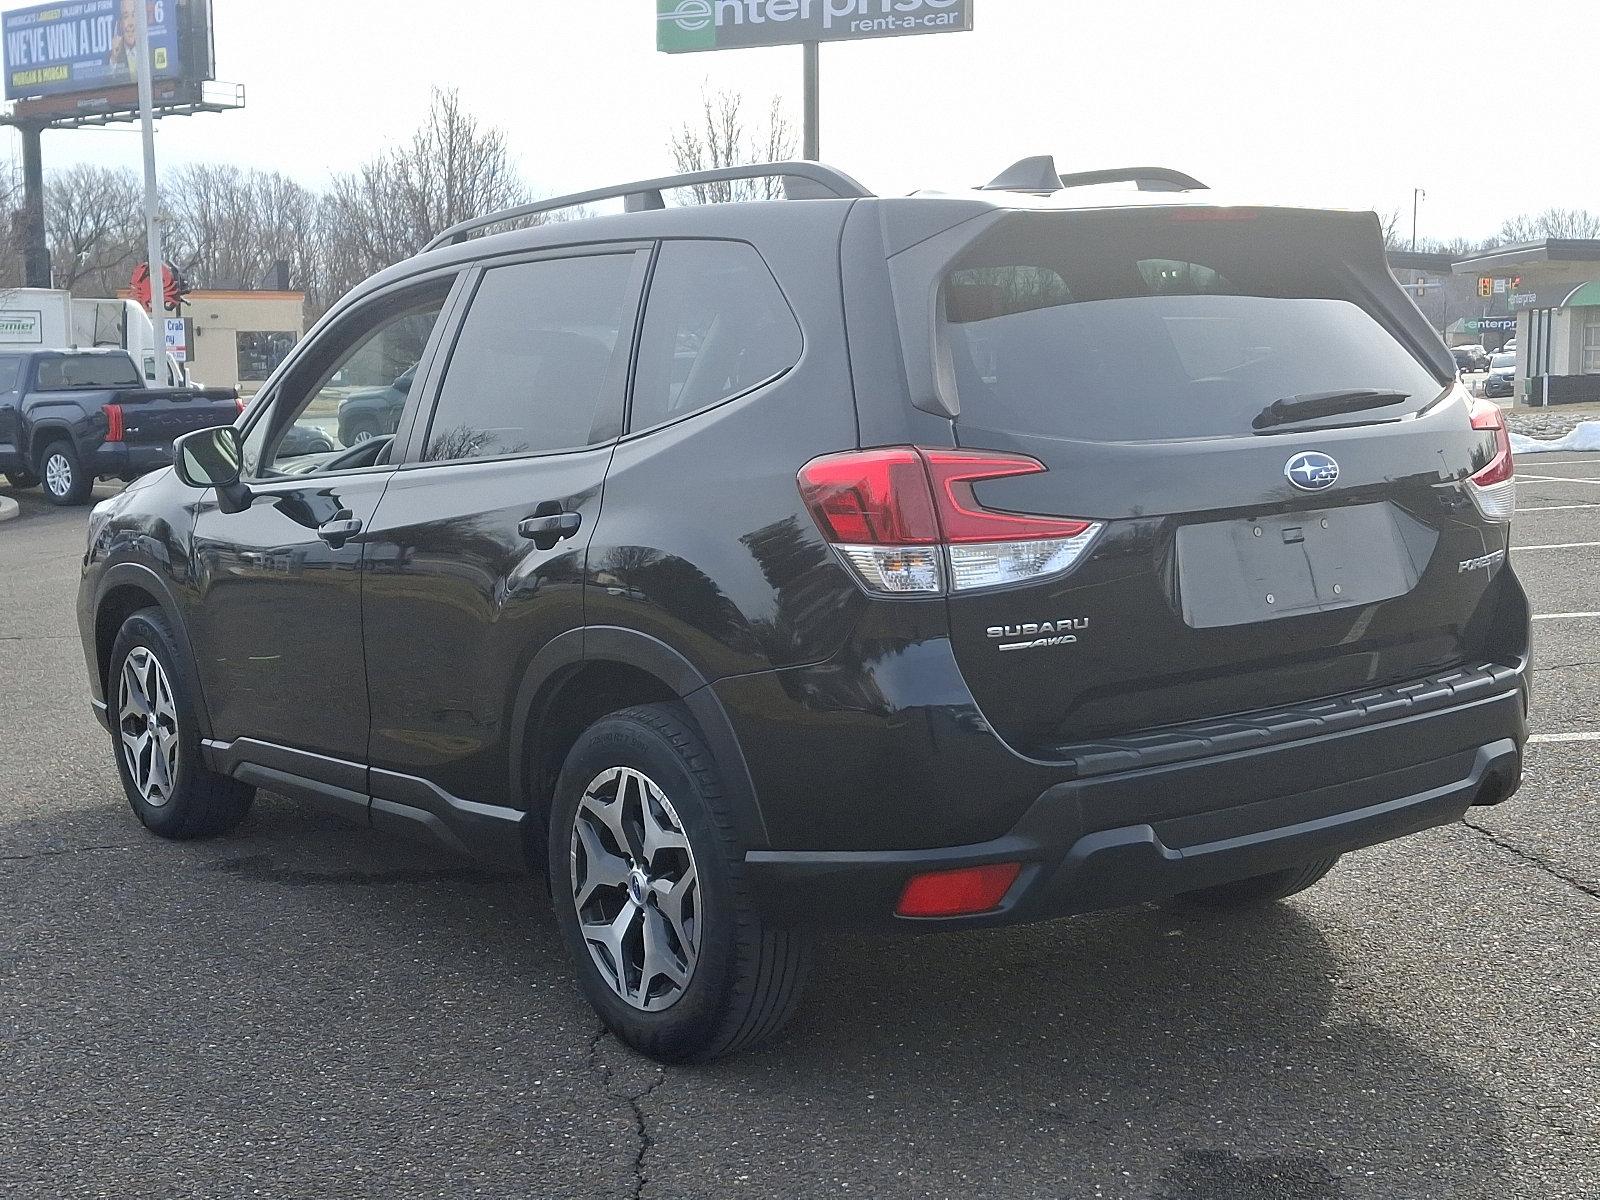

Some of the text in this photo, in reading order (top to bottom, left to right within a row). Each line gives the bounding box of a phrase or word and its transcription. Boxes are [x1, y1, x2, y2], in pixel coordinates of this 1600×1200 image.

[155, 0, 164, 23] 6
[657, 0, 957, 30] enterp
[851, 12, 959, 32] rent-a-car
[8, 14, 114, 66] WE'VE WON A LOT
[168, 320, 184, 331] Crab
[986, 617, 1089, 638] SUBARU
[1026, 635, 1078, 648] AWD
